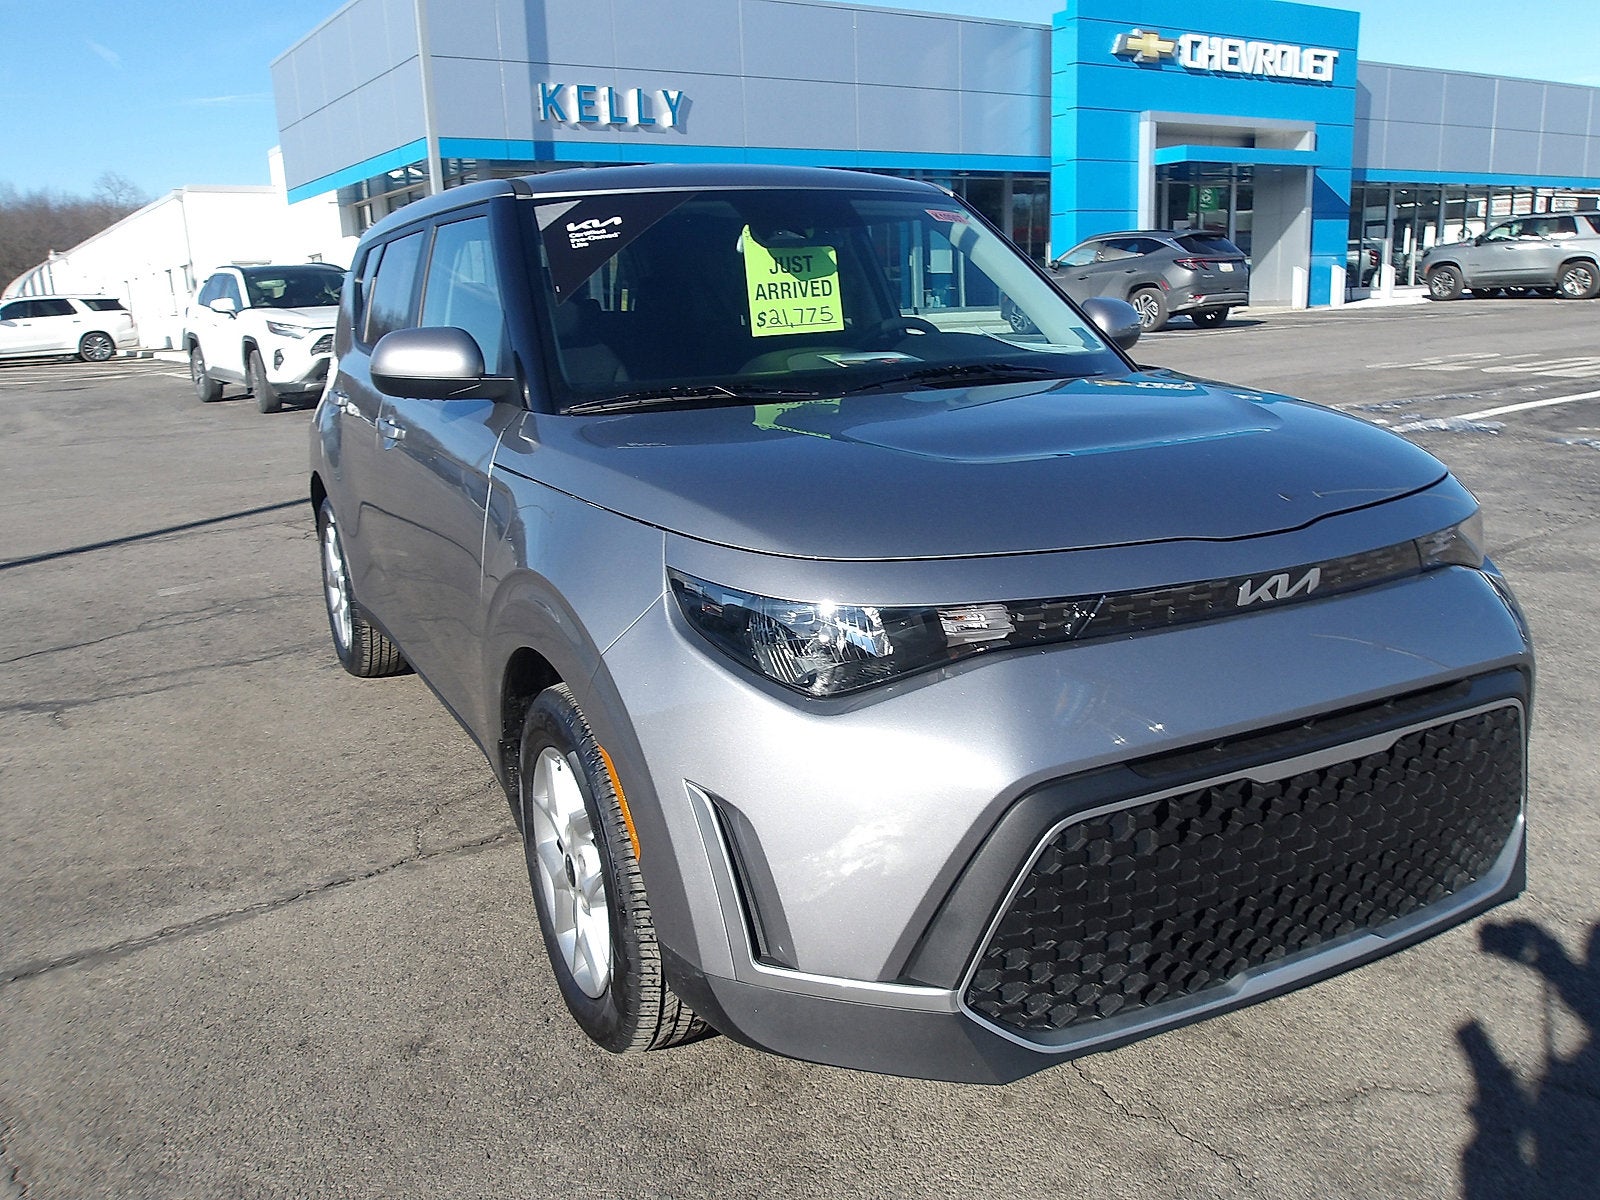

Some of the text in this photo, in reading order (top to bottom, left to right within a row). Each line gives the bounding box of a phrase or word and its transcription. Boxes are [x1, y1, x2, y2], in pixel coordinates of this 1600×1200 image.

[1178, 34, 1339, 82] CHEVROLET
[538, 82, 684, 127] KELLY
[569, 229, 606, 238] Certified
[769, 255, 813, 275] JUST
[755, 280, 833, 301] ARRIVED
[757, 306, 834, 328] $21,775
[1237, 567, 1320, 606] KIA
